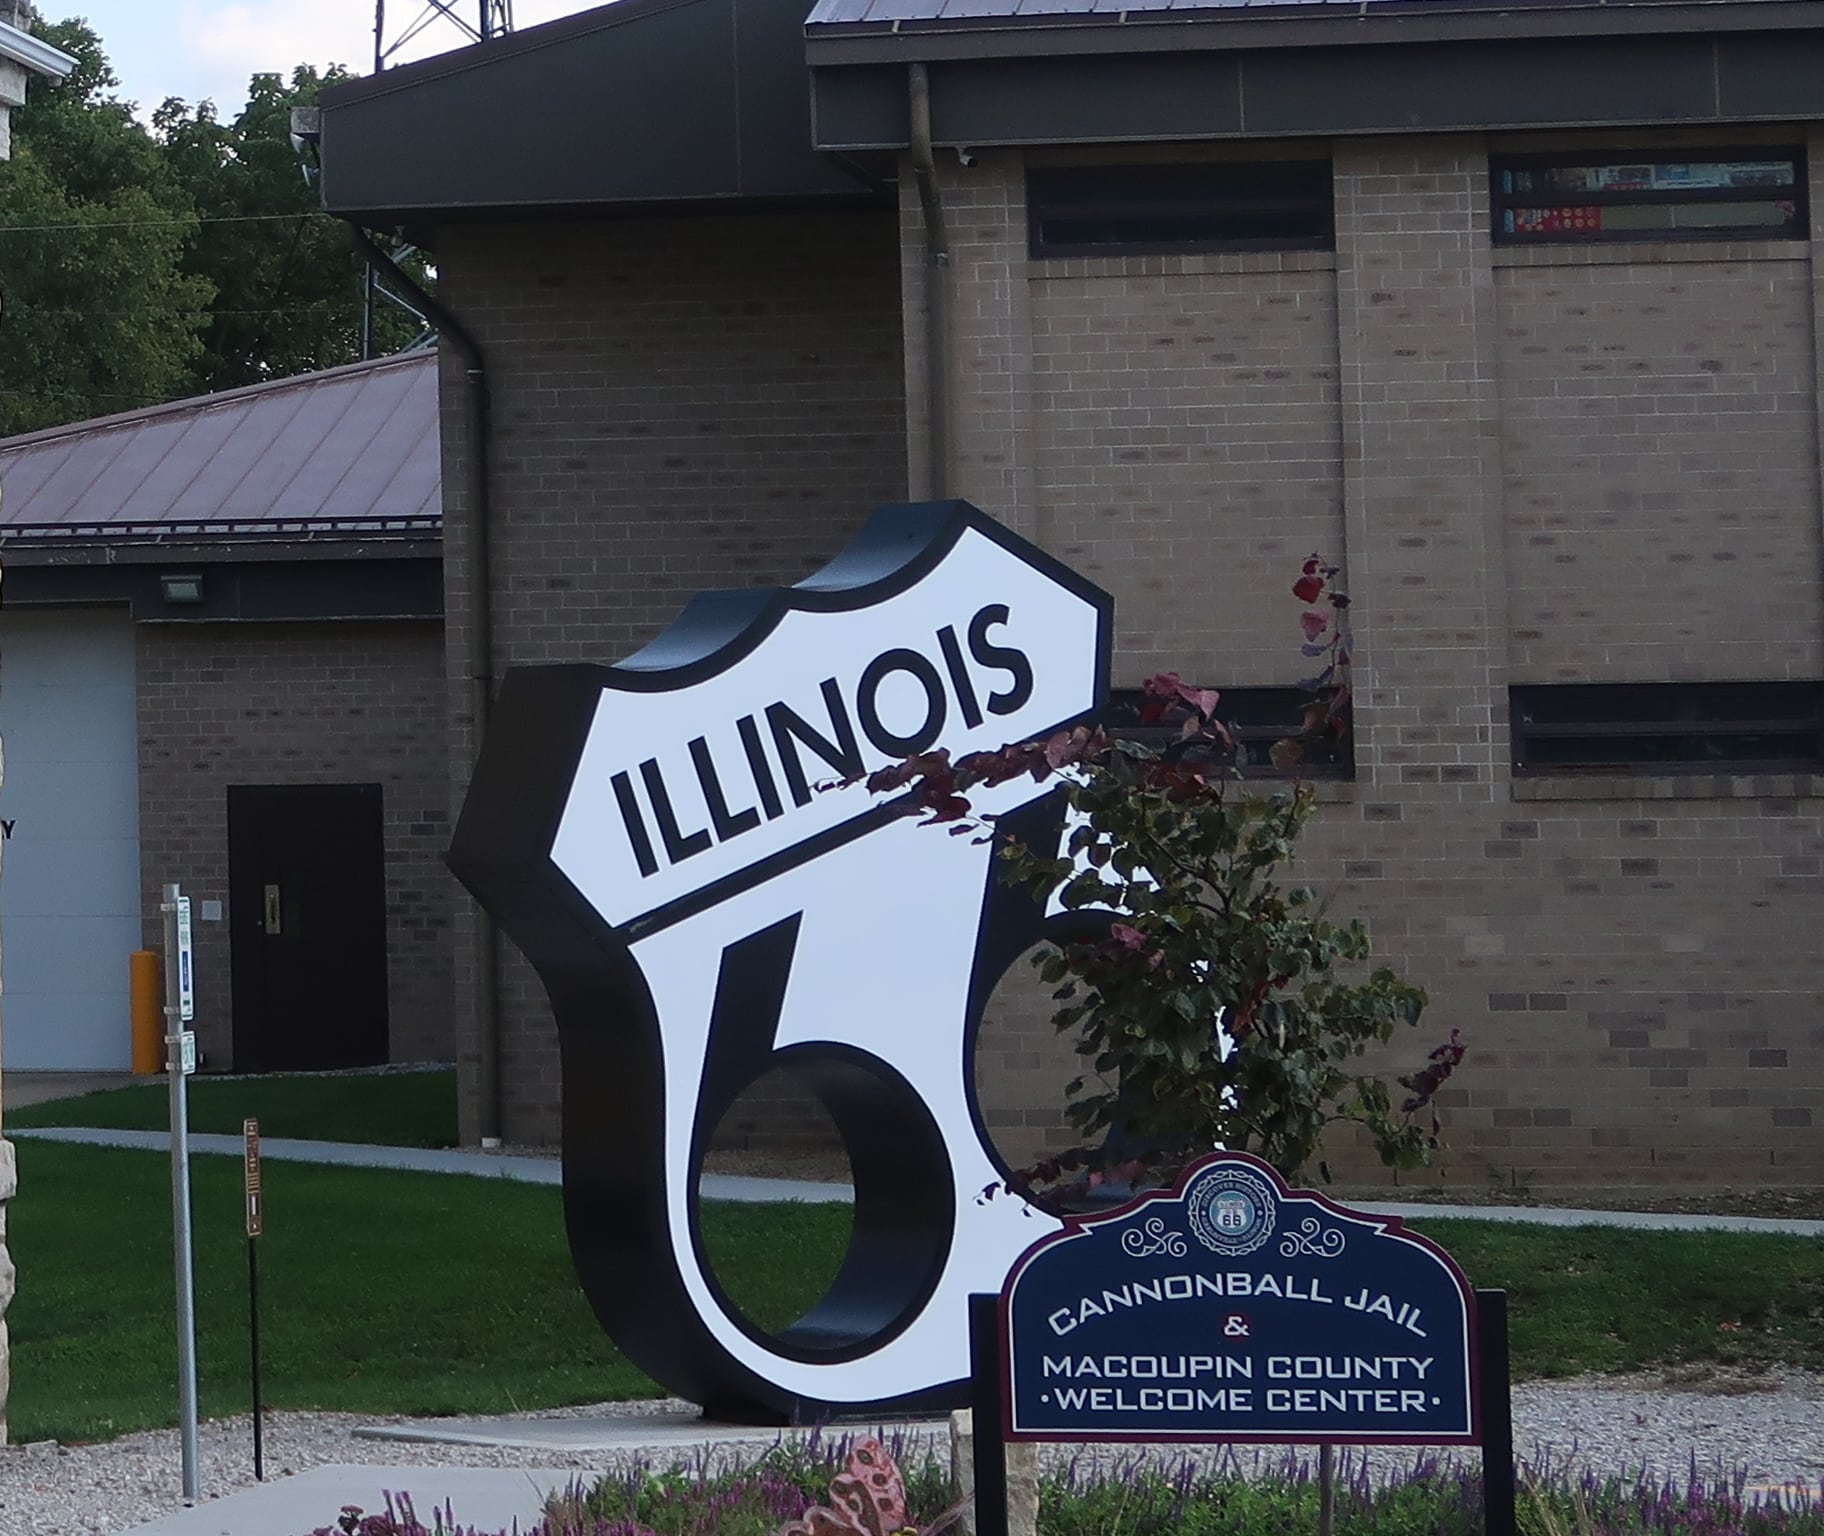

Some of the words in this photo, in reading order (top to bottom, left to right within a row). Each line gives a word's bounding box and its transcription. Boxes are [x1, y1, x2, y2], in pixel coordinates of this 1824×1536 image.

[610, 603, 1034, 878] ILLINOIS
[1223, 1214, 1241, 1226] 66
[1048, 1272, 1332, 1337] CANNONBALL
[1344, 1287, 1428, 1337] JAIL
[1224, 1316, 1250, 1337] &
[1042, 1356, 1252, 1378] MACOUPIN
[1267, 1357, 1434, 1379] COUNTY
[1054, 1388, 1252, 1412] WELCOME
[1265, 1389, 1427, 1412] CENTER
